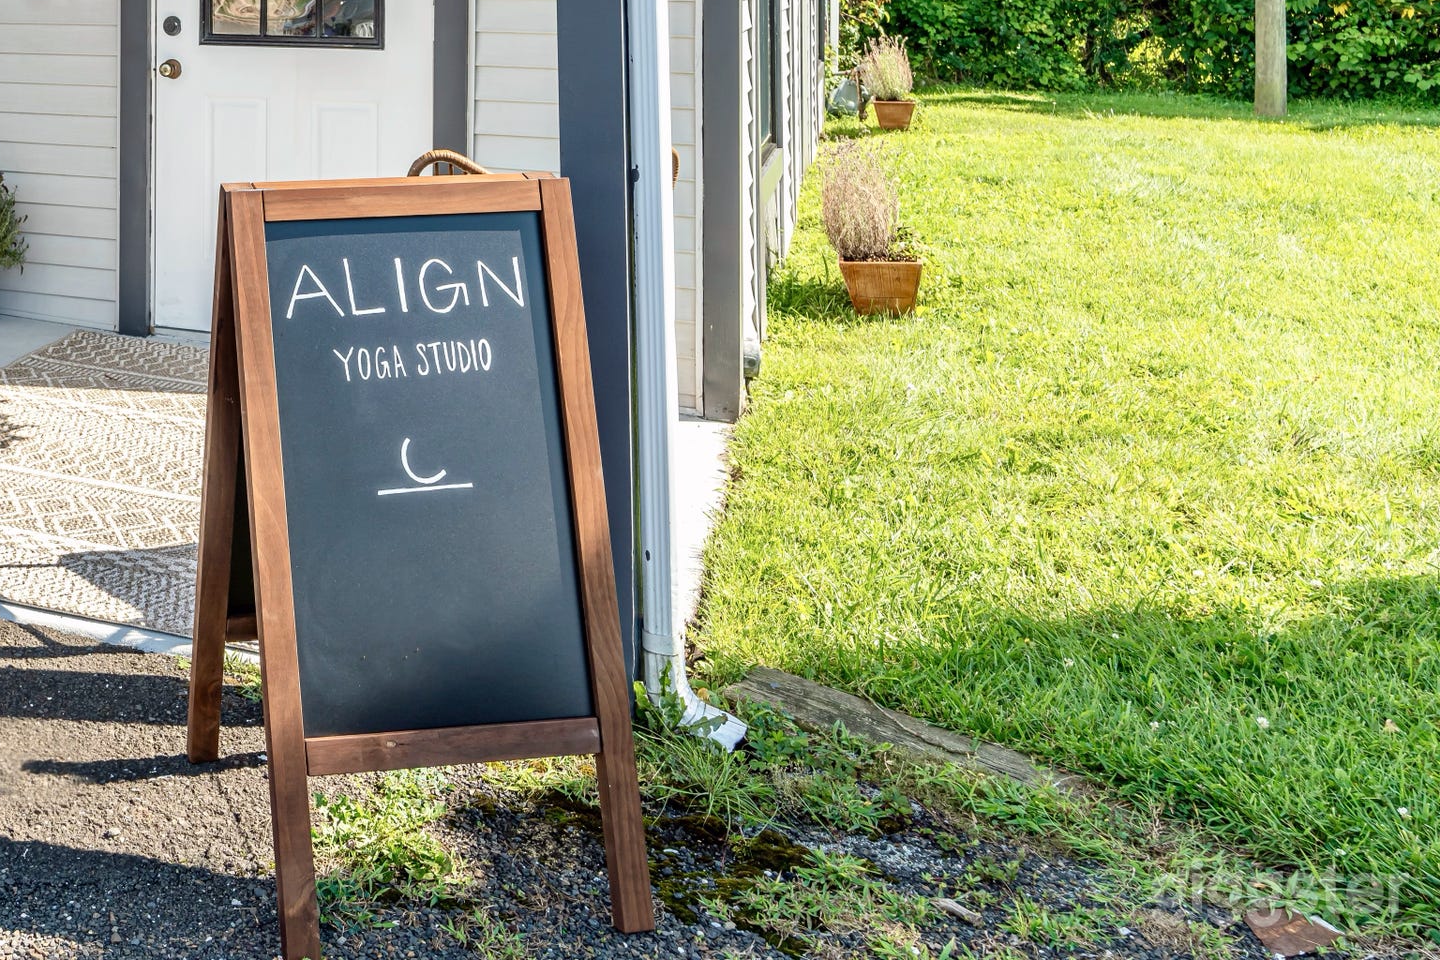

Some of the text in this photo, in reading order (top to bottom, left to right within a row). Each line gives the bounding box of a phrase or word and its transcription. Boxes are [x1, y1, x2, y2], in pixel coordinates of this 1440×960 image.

[286, 256, 526, 319] ALIGN
[333, 338, 492, 381] YOGA STUDIO
